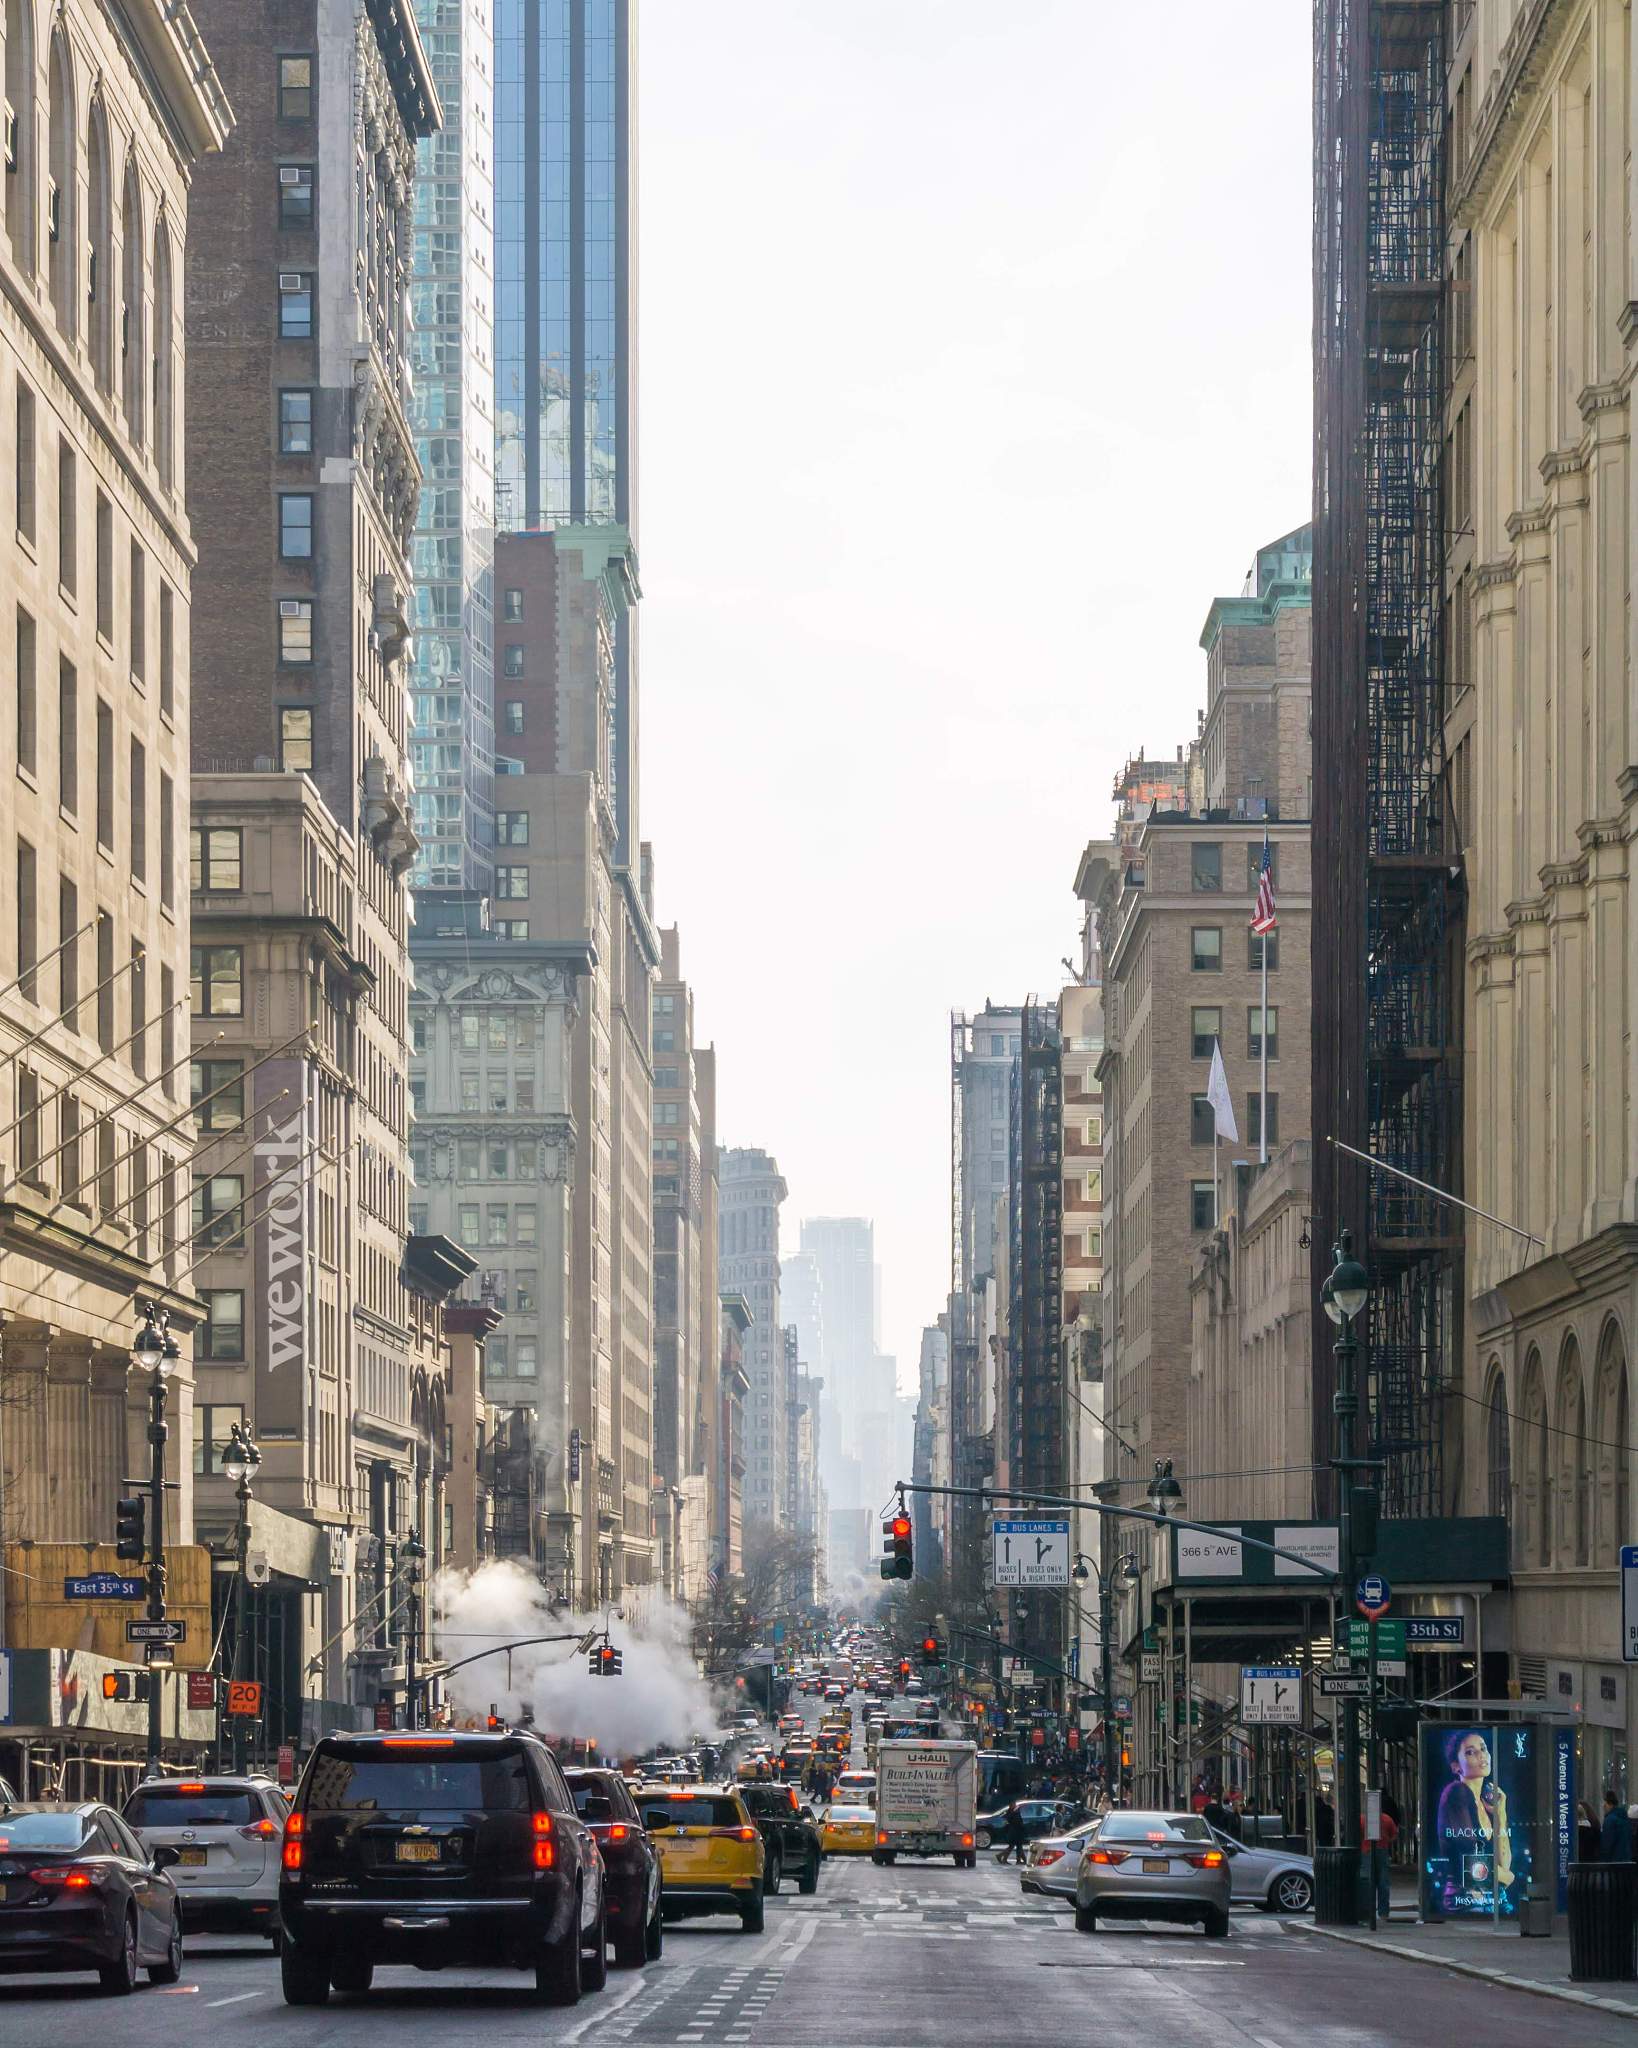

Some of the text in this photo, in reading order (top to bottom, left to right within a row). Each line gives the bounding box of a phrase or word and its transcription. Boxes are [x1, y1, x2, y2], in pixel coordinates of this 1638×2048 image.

[253, 1113, 303, 1373] wework
[1012, 1524, 1052, 1532] BUS LANES
[1181, 1547, 1201, 1557] 366
[1216, 1546, 1238, 1556] AVE
[998, 1565, 1017, 1574] BUSES
[1026, 1565, 1062, 1574] BUSES ONLY
[999, 1575, 1015, 1583] ONLY
[1029, 1575, 1046, 1583] RIGHT
[1047, 1575, 1067, 1583] TURNS
[74, 1582, 134, 1594] East 35th St
[137, 1627, 174, 1636] ONE WAY
[1410, 1623, 1458, 1636] 35th St
[1329, 1681, 1371, 1690] ONE WA
[232, 1685, 257, 1702] 20
[907, 1754, 949, 1763] U-HAUL
[1558, 1743, 1569, 1878] 5 Avenue & West 35 Street
[1445, 1827, 1512, 1838] BLACK OPM
